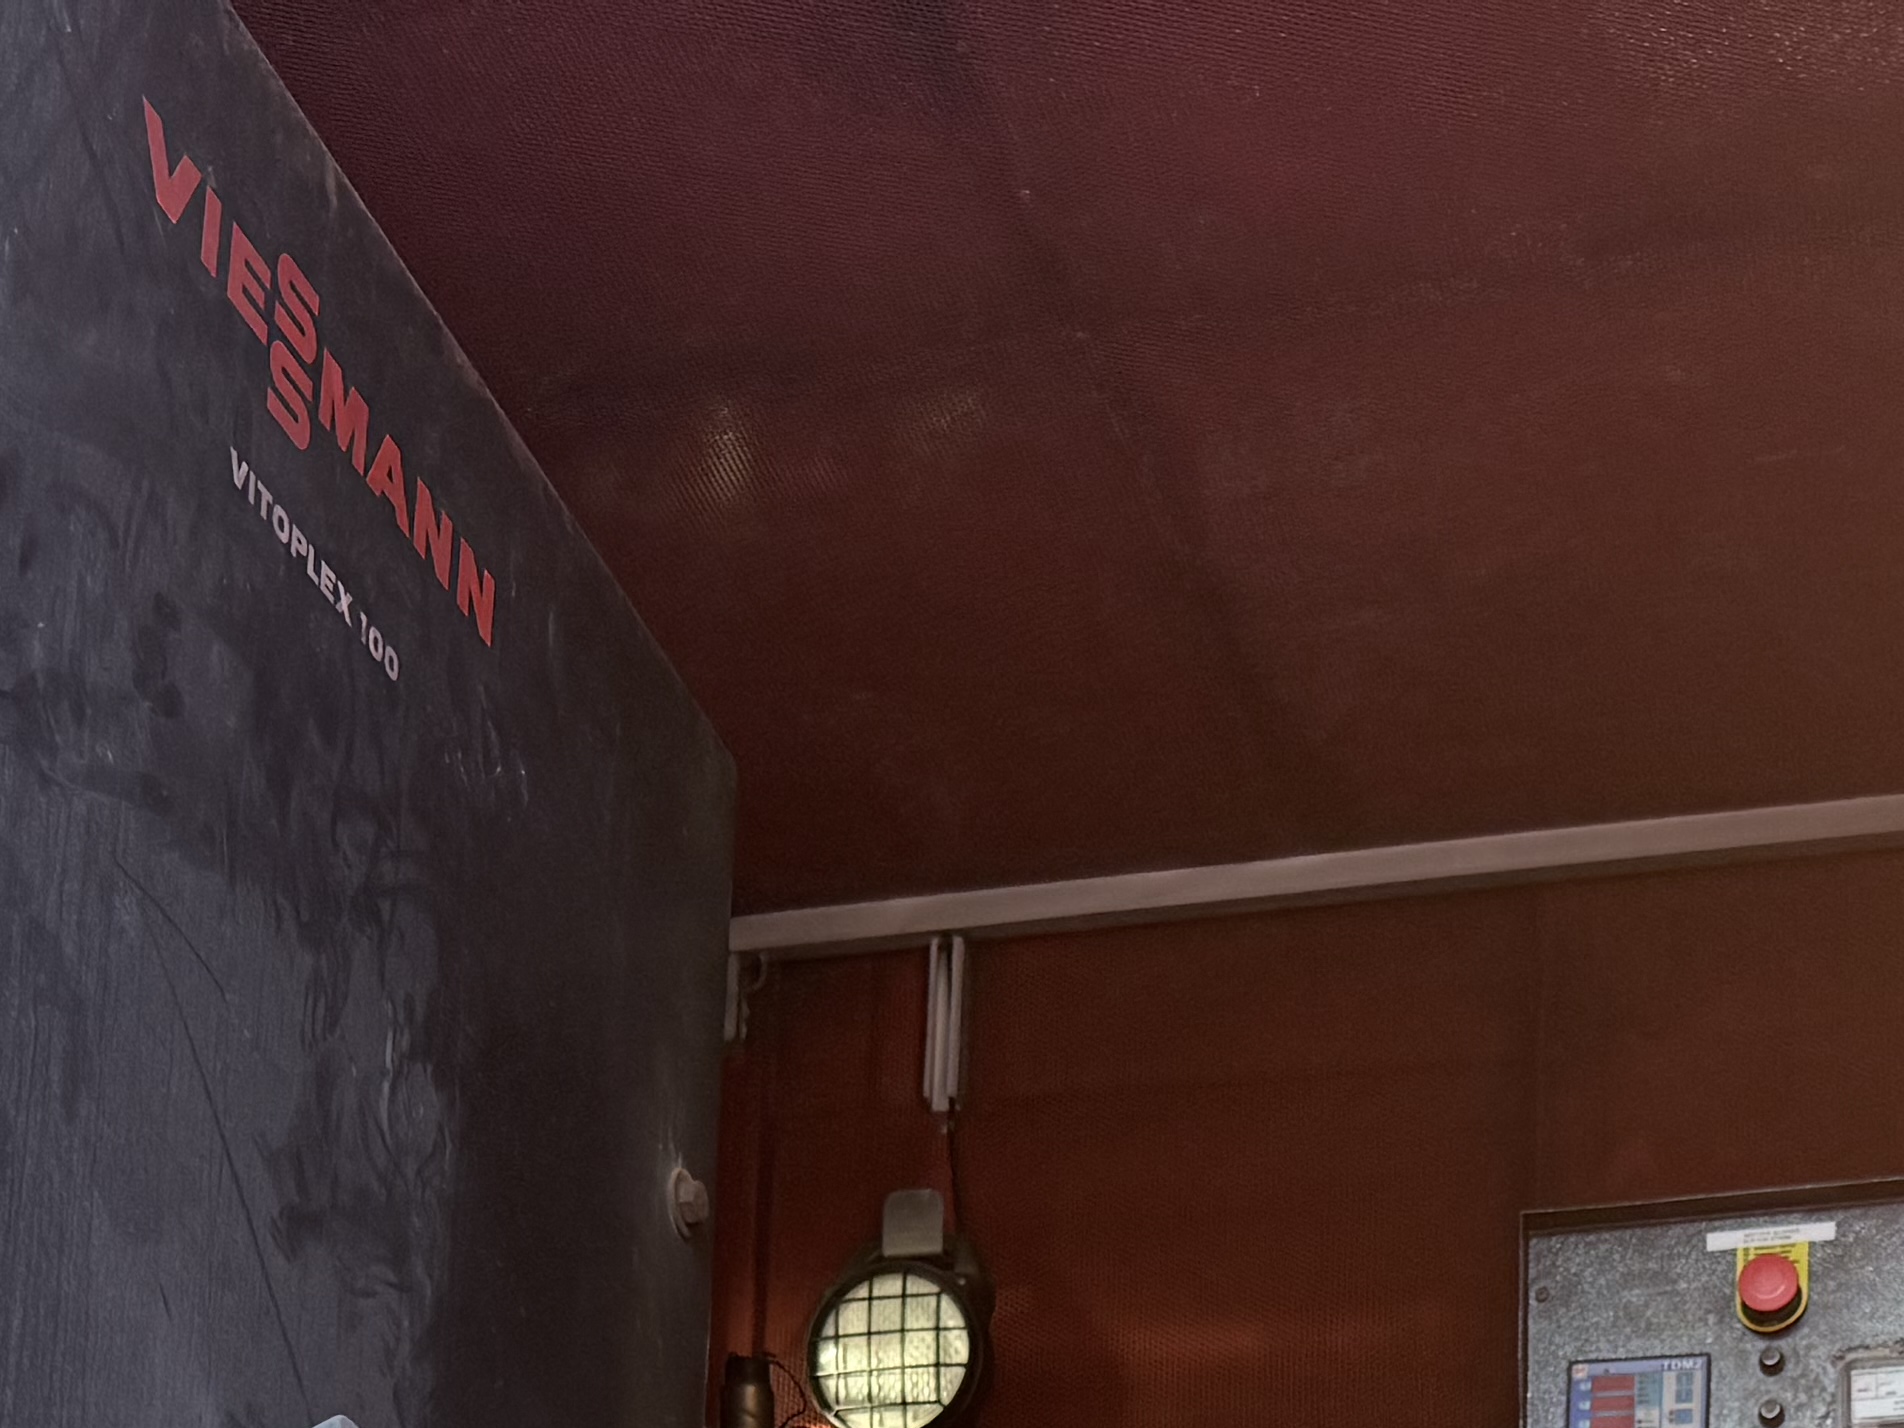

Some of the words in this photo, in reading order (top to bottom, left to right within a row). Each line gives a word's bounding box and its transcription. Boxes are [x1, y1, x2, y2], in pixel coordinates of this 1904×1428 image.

[142, 95, 495, 646] VIESSMANN
[229, 446, 353, 627] VITOPLEX
[359, 611, 400, 682] 100
